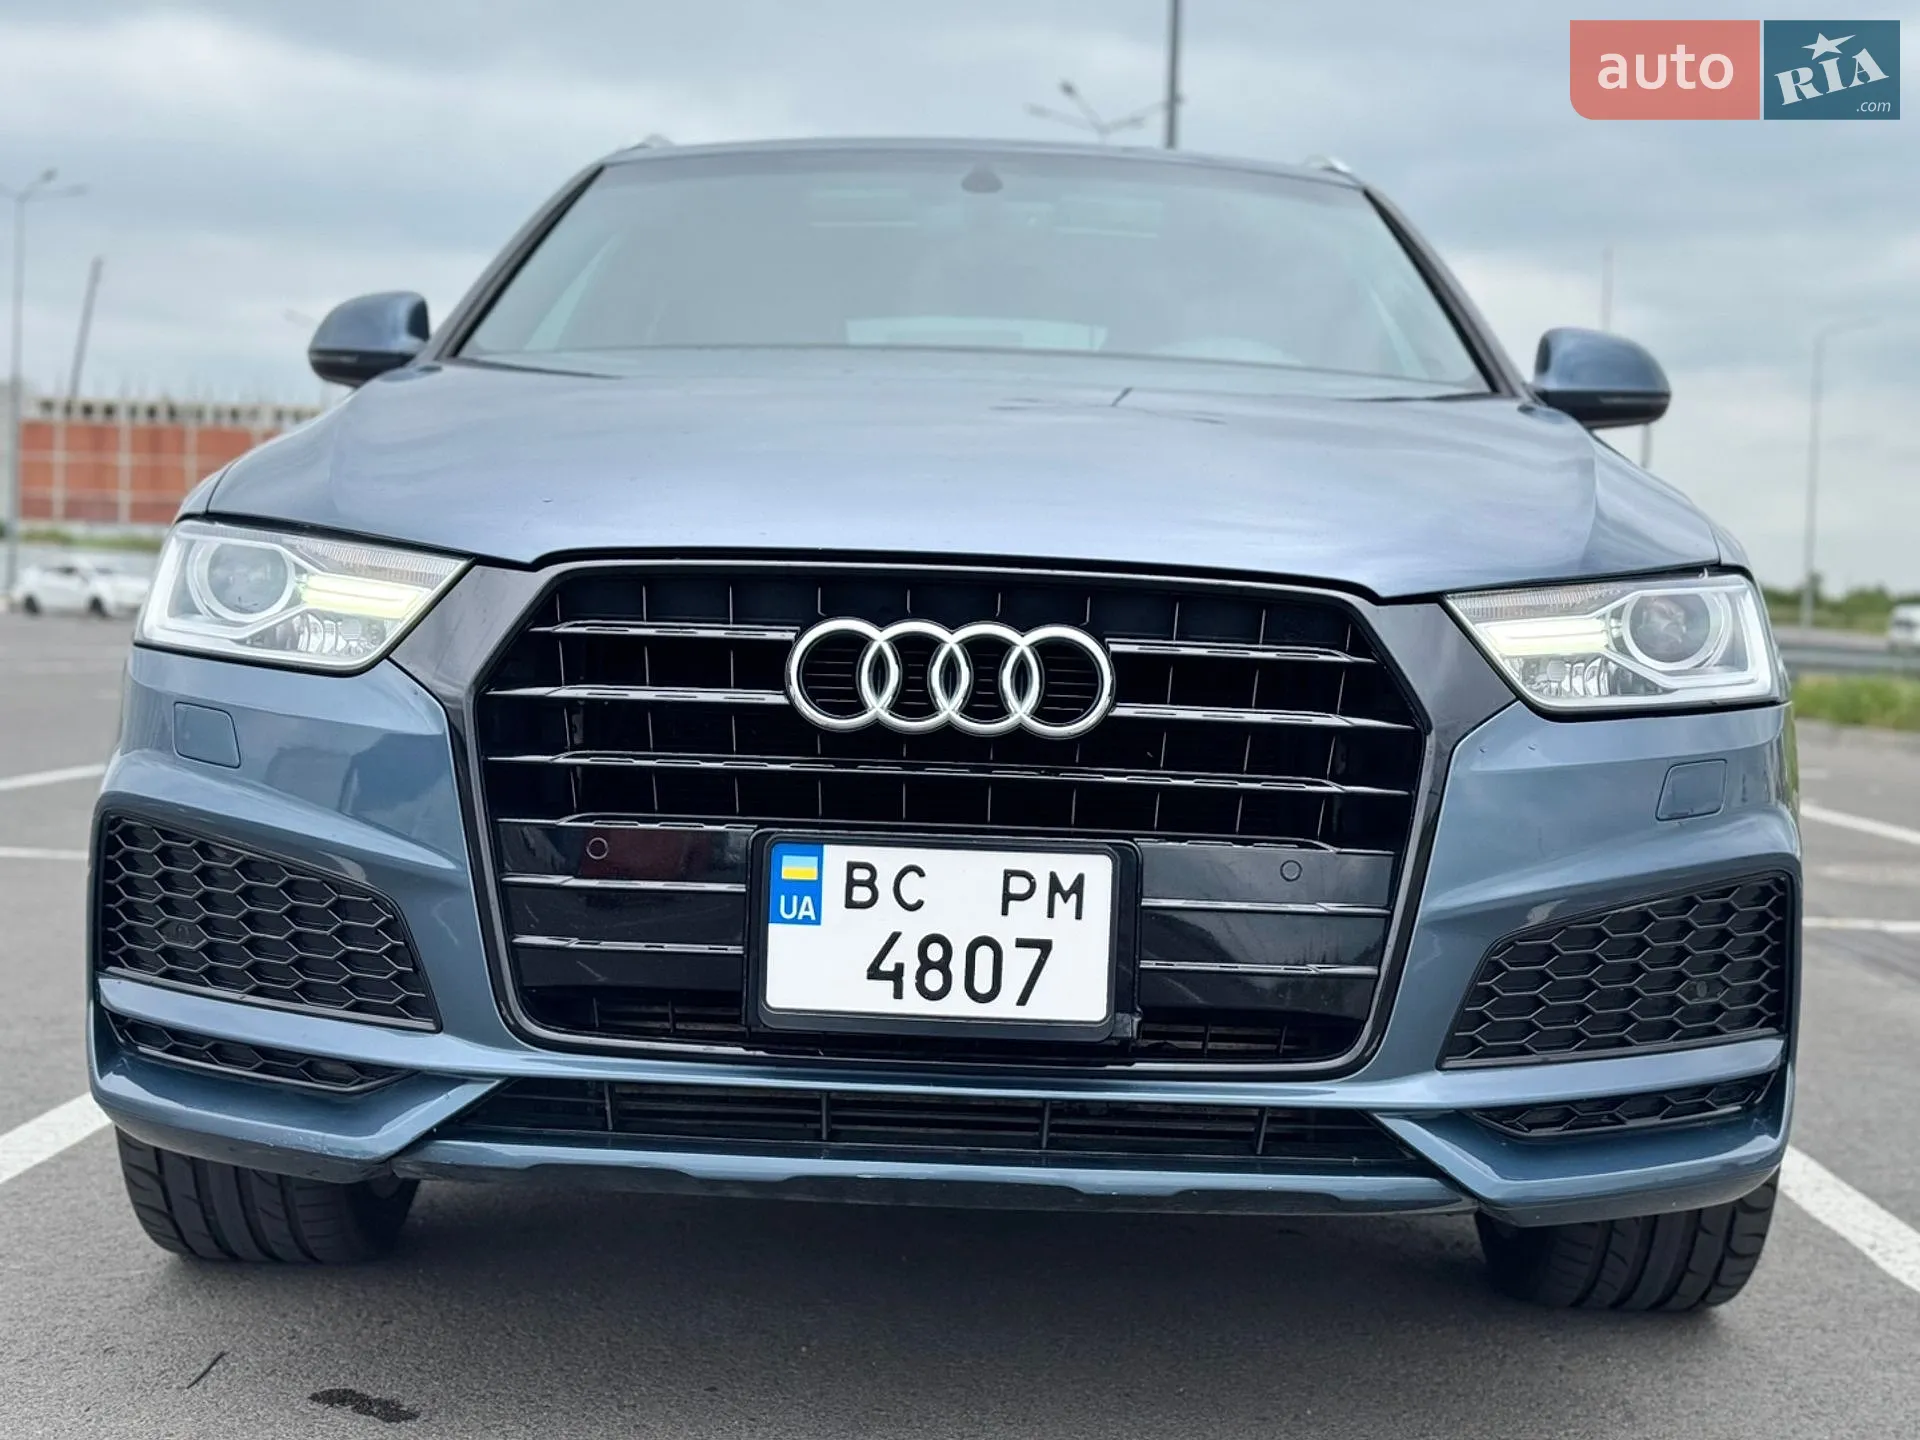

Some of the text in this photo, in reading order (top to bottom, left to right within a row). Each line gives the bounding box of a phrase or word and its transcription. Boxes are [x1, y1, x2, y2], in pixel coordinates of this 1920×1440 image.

[779, 894, 816, 921] UA
[844, 860, 1085, 920] BC PM
[866, 931, 1053, 1006] 4807
